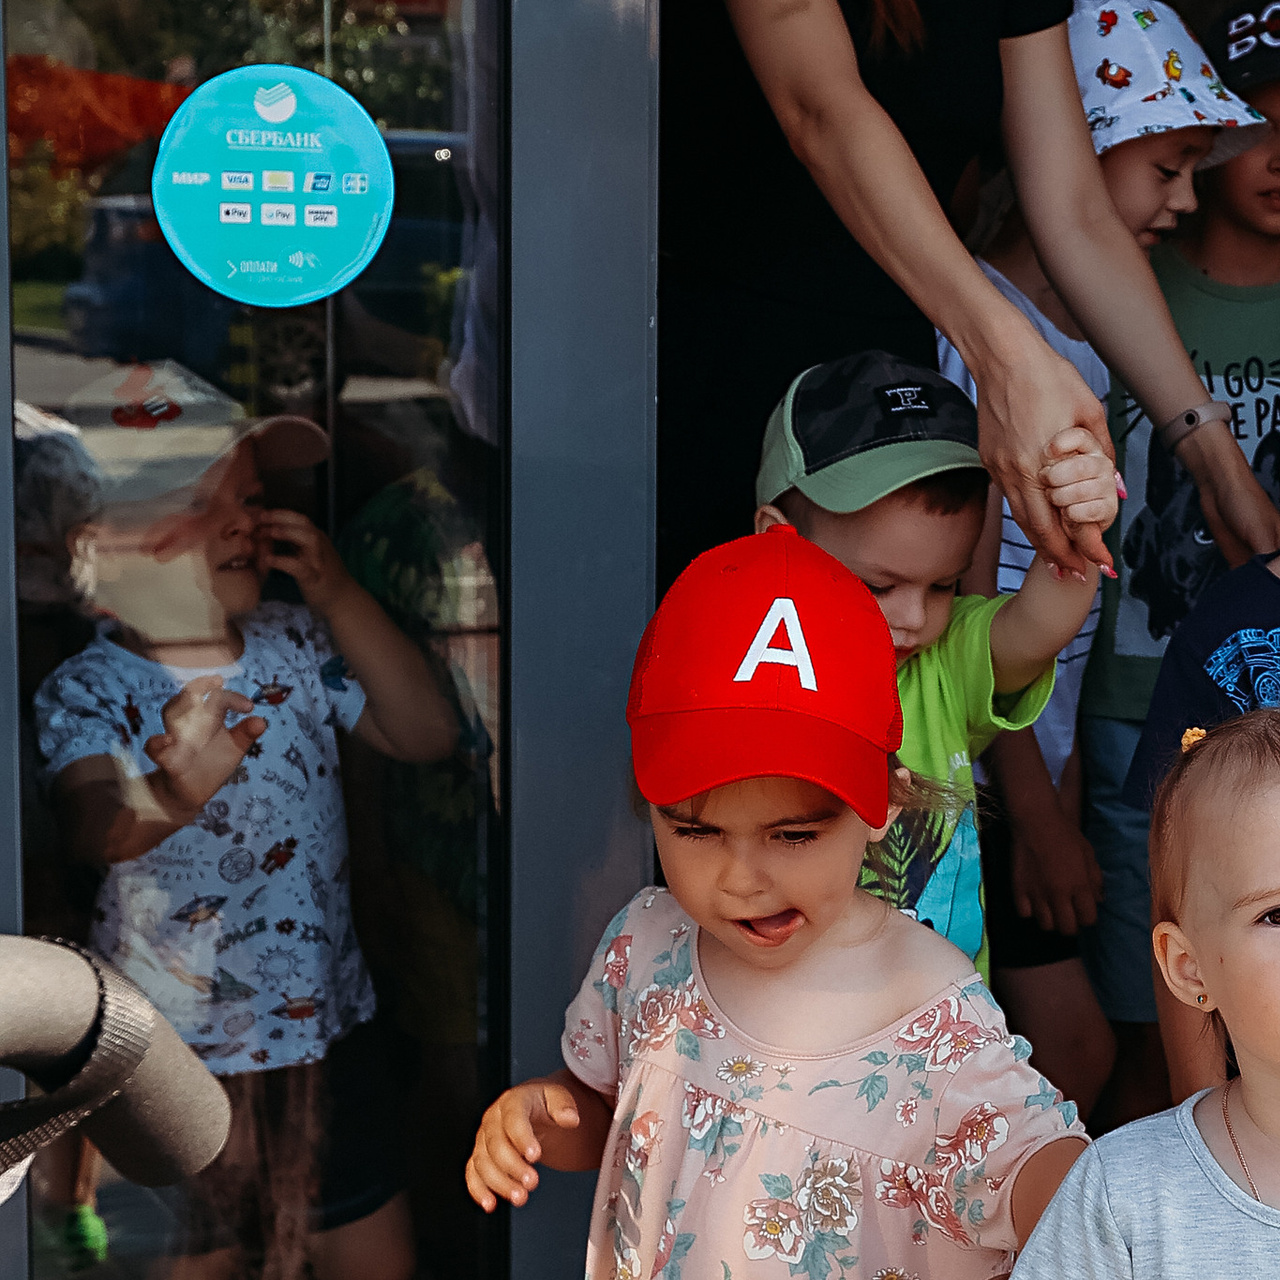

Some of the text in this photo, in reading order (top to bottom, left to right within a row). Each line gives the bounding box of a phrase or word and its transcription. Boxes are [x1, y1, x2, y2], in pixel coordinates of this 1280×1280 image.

[225, 129, 323, 148] СБЕРБАНК
[226, 175, 250, 185] VISA
[1224, 356, 1265, 398] GO
[732, 596, 819, 692] A
